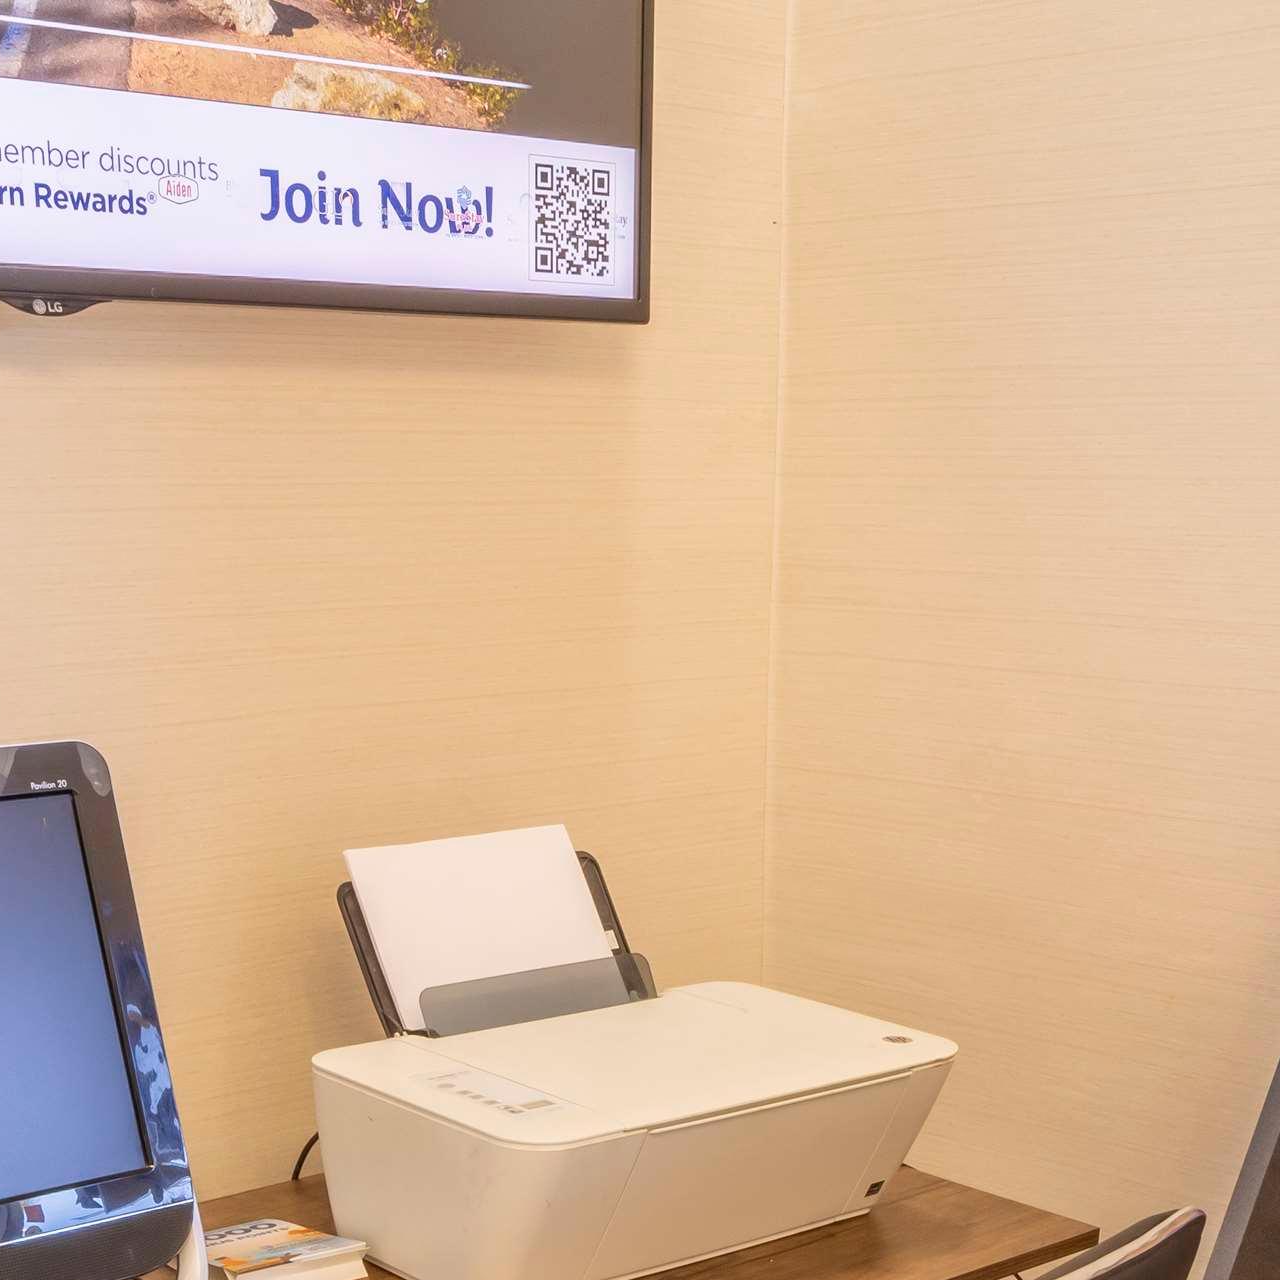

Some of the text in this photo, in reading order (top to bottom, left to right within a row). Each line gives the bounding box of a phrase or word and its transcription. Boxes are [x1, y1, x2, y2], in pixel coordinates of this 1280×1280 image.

[98, 146, 219, 181] discounts
[259, 169, 495, 238] Join Now!
[48, 301, 63, 314] LG
[31, 781, 55, 790] Pavilion
